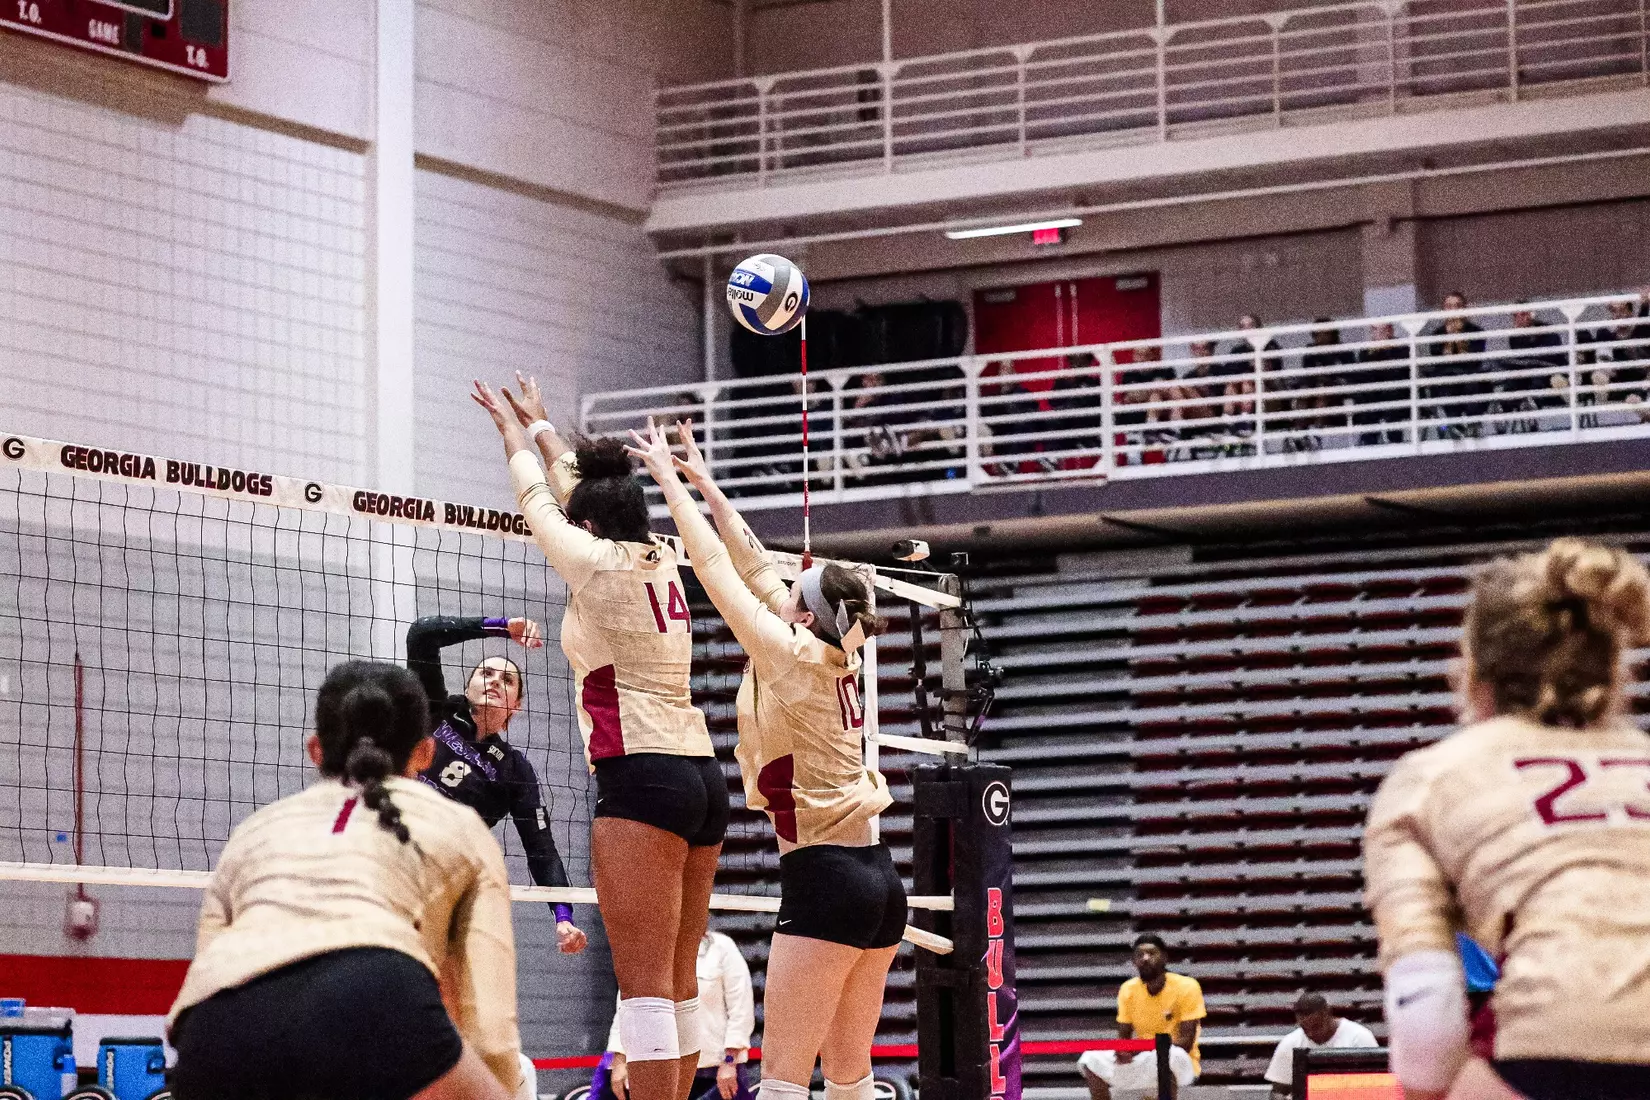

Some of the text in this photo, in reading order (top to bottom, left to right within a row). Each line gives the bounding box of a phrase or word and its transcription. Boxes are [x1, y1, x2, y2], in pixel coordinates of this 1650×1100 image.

[2, 437, 25, 460] G
[60, 445, 156, 480] GEORGIA
[166, 459, 273, 497] BULLDOGS
[304, 482, 323, 503] G
[353, 490, 436, 522] GEORGIA
[643, 580, 692, 634] 14
[835, 673, 863, 731] 10
[332, 795, 359, 836] 1
[982, 781, 1010, 825] G
[986, 887, 1007, 1100] BULL
